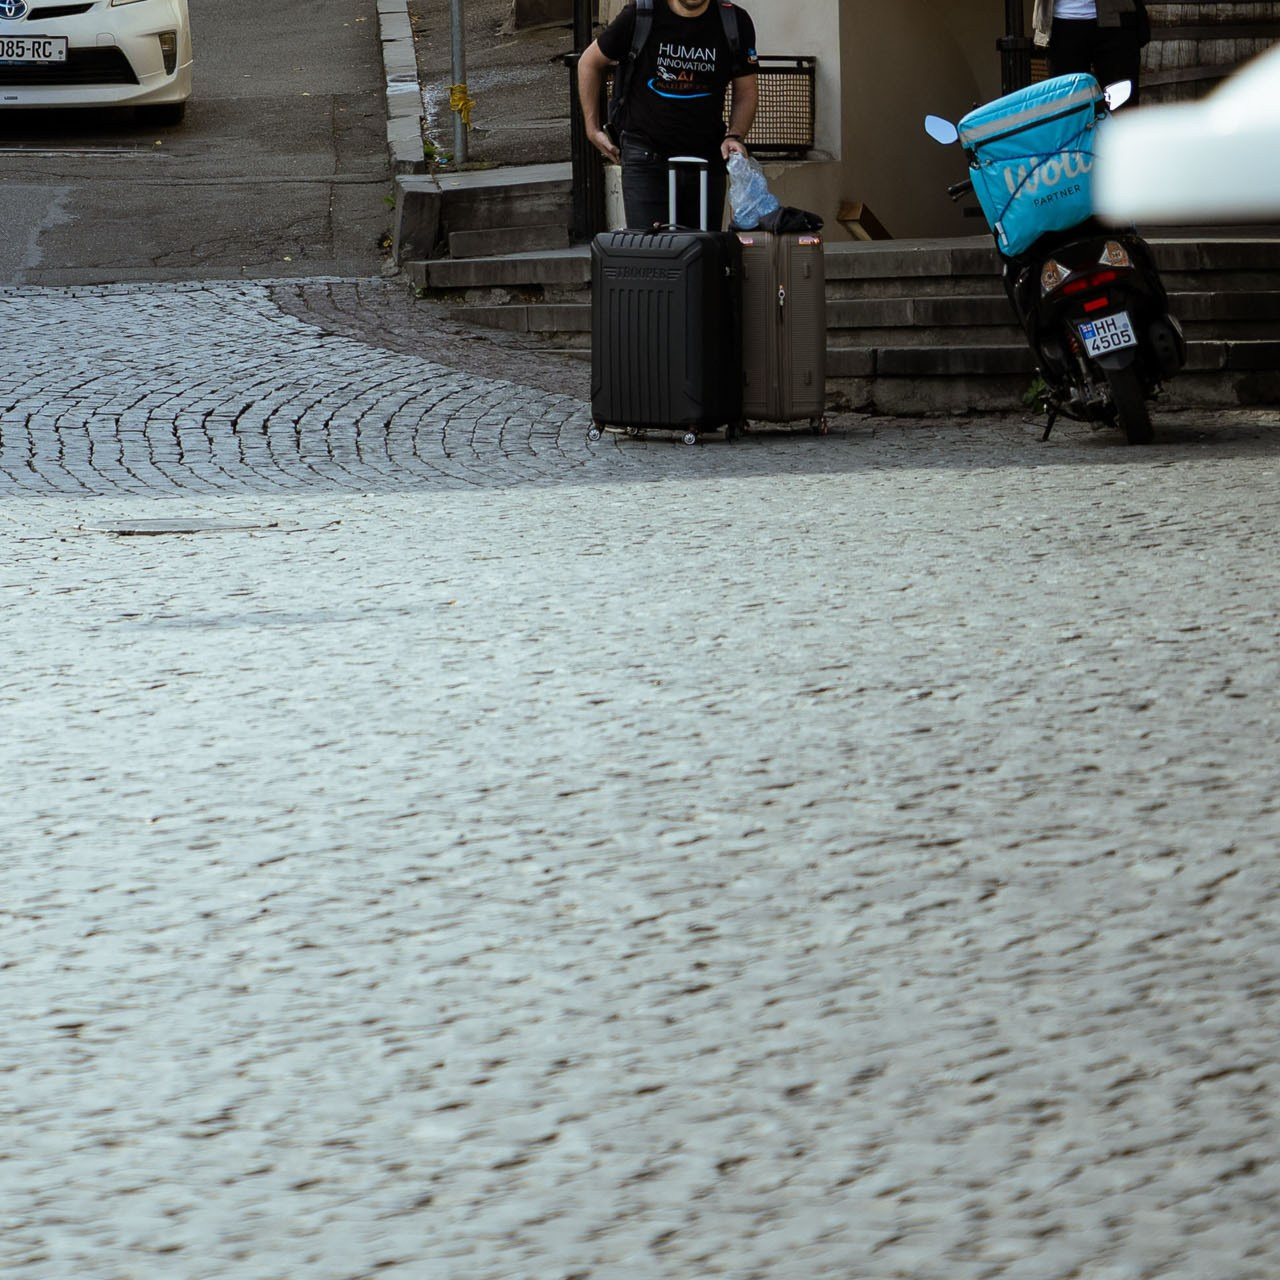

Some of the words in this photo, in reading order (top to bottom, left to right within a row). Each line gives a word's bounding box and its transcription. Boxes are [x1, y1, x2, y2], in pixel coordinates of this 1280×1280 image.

[658, 41, 717, 62] HUMAN
[656, 56, 716, 73] INNOVATION
[1032, 183, 1081, 208] PARTNER
[1093, 317, 1118, 337] HH
[1091, 329, 1132, 352] 4505
